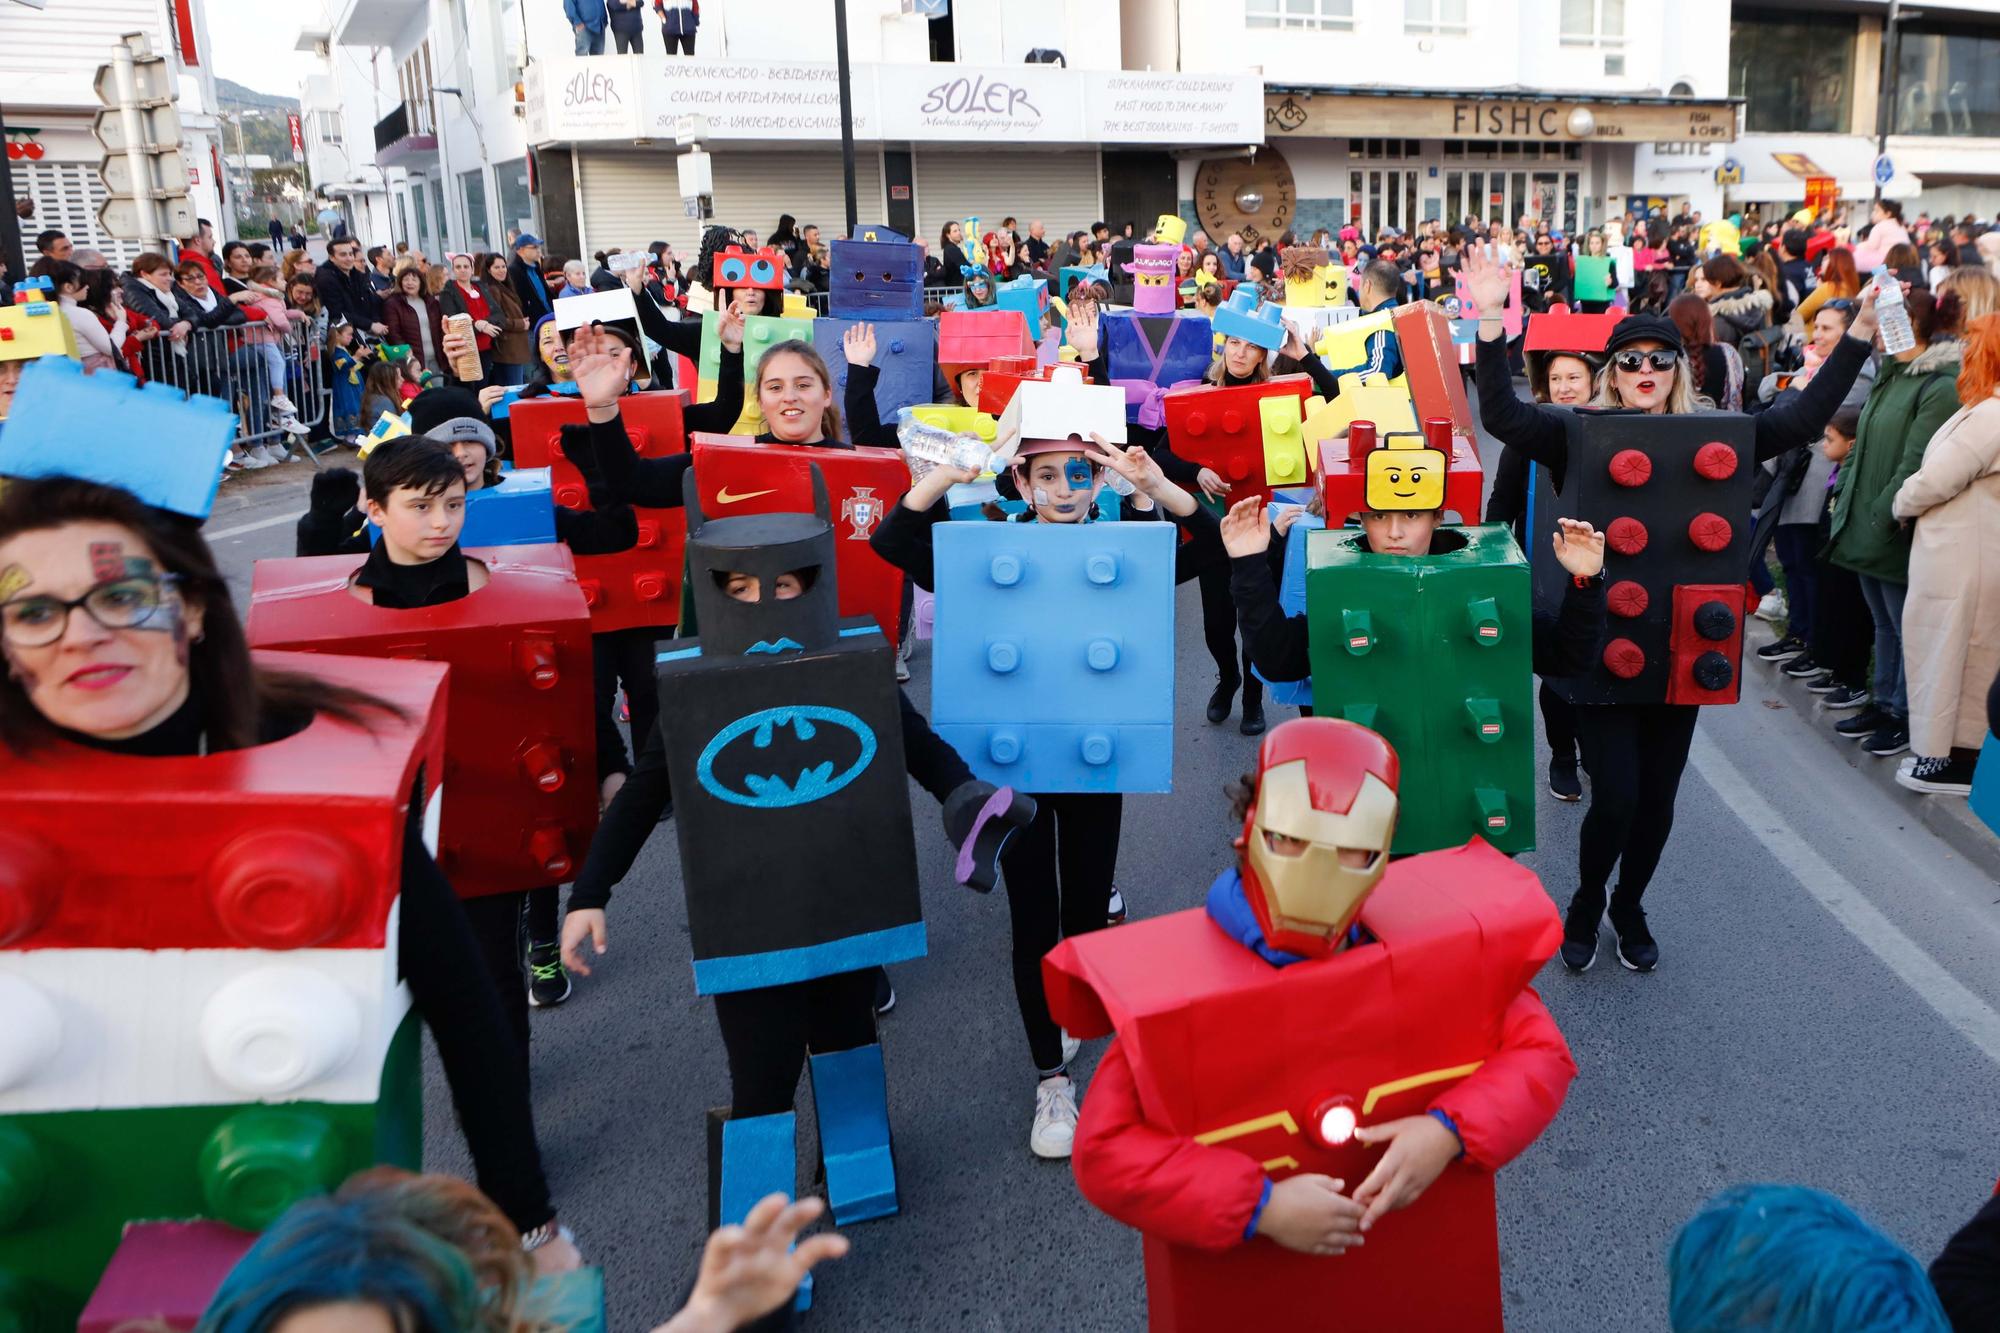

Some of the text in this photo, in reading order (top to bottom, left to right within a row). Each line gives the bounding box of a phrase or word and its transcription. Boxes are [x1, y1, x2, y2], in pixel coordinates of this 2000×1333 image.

[664, 64, 758, 79] SUPERMERCADO
[768, 67, 819, 80] BEBIDAS
[564, 66, 621, 106] SOLER
[670, 90, 722, 104] COMIDA
[770, 91, 802, 105] PARA
[803, 92, 840, 105] LLEVA
[921, 74, 1041, 117] SOLER
[1114, 100, 1138, 112] FAST
[1139, 100, 1164, 112] FOOD
[730, 115, 787, 129] VARIEDAD
[788, 116, 803, 129] EN
[804, 116, 865, 129] CAMISAS
[922, 116, 961, 127] Makes
[962, 115, 1012, 131] shopping
[1689, 112, 1710, 123] FISH
[1597, 125, 1624, 136] IBIZA
[1699, 126, 1726, 137] CHIPS
